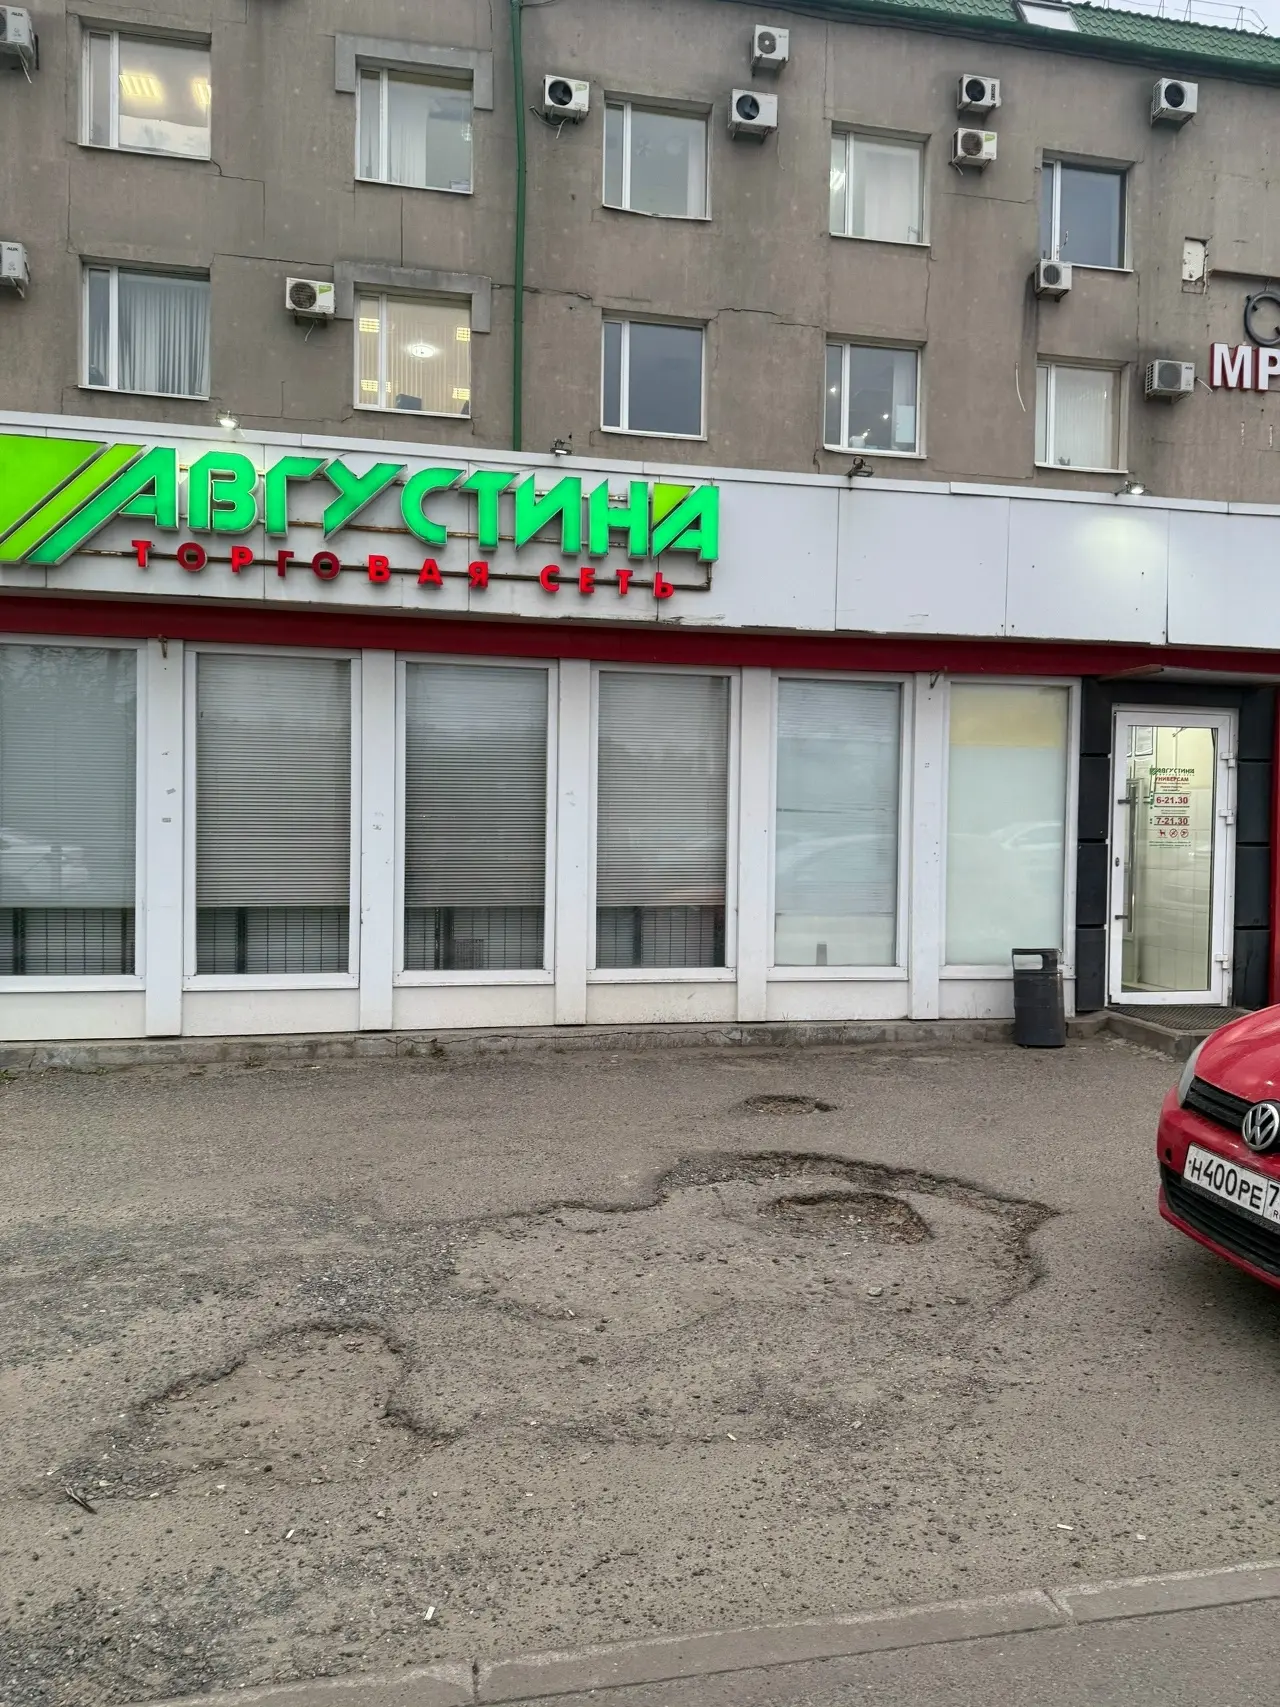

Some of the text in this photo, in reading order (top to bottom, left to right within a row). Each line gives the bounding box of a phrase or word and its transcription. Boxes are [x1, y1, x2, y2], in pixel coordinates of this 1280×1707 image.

[26, 446, 720, 565] АВГУСТИНА
[130, 539, 675, 599] ТОРГОВАЯ СЕТЬ
[1156, 796, 1189, 804] 6-21.30
[1156, 817, 1188, 825] 7-21.30
[1190, 1157, 1263, 1210] Н400РЕ
